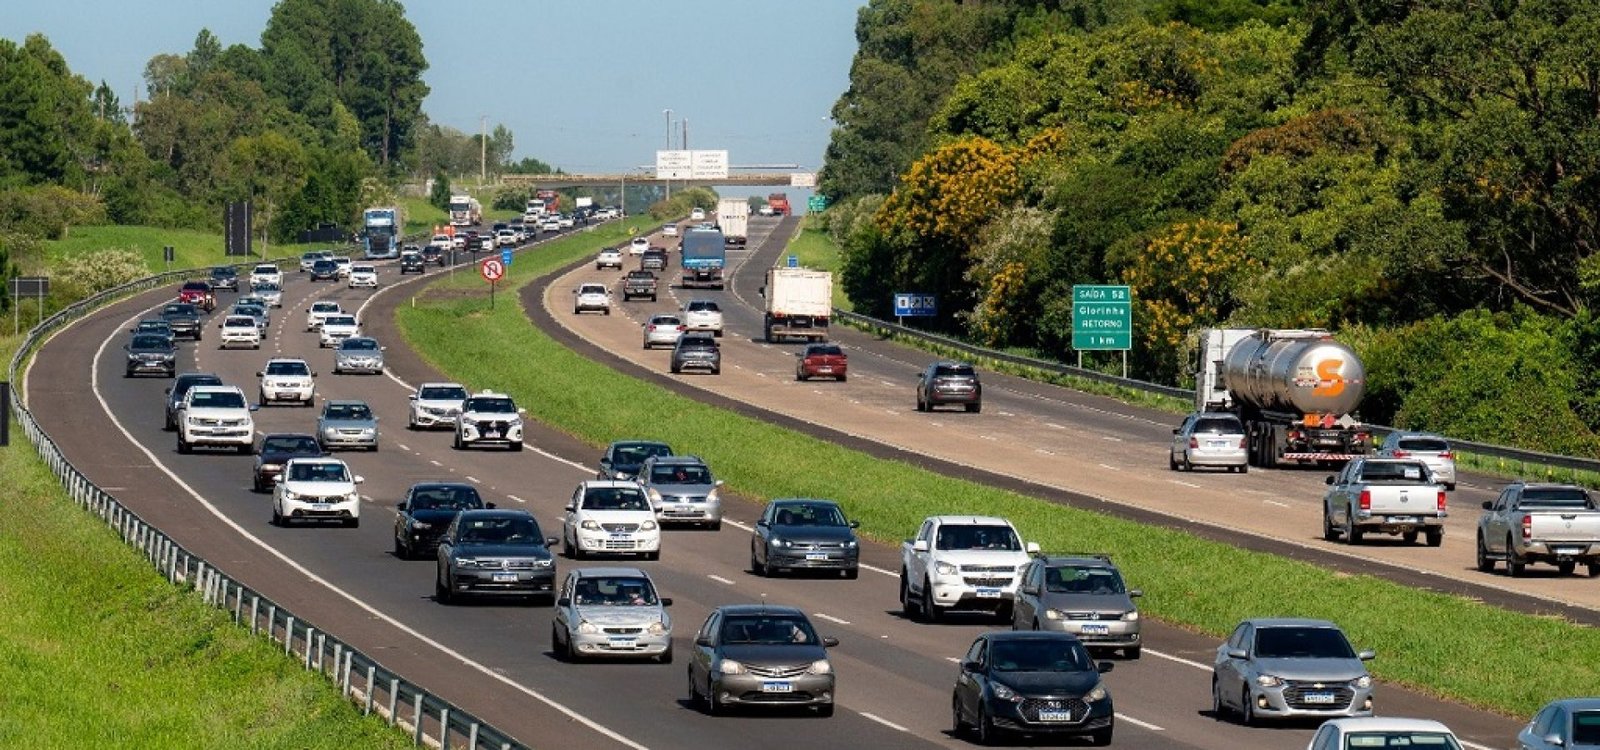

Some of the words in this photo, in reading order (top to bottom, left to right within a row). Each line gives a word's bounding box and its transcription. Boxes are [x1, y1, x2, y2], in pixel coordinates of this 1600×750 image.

[1079, 288, 1105, 299] SAÍDA
[1112, 290, 1124, 299] 52
[1079, 306, 1124, 314] Glorinha
[1082, 320, 1122, 328] RETORNO
[1090, 336, 1094, 344] 1
[1100, 336, 1114, 344] km
[1312, 358, 1345, 397] S
